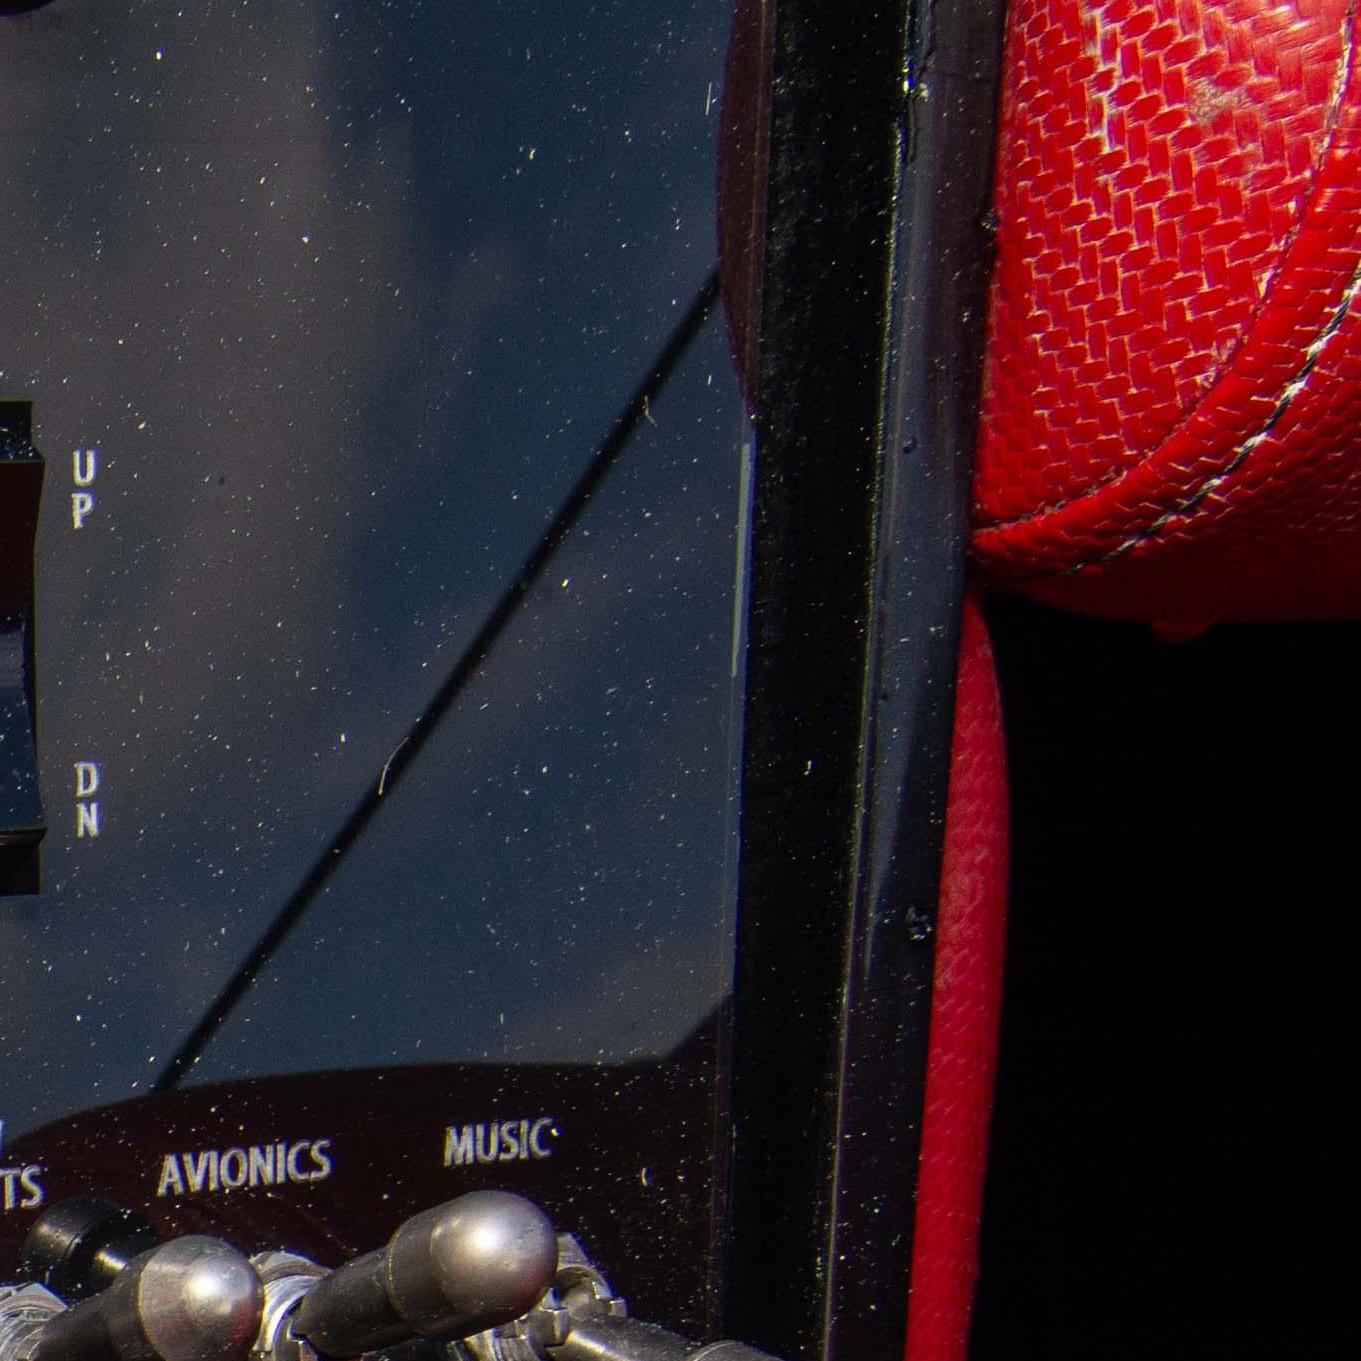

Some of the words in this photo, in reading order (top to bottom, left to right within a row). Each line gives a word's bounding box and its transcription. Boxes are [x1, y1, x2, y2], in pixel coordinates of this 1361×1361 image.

[71, 449, 97, 529] UP
[74, 761, 101, 838] DN
[156, 1139, 333, 1198] AVIONICS
[443, 1116, 551, 1168] MUSIC
